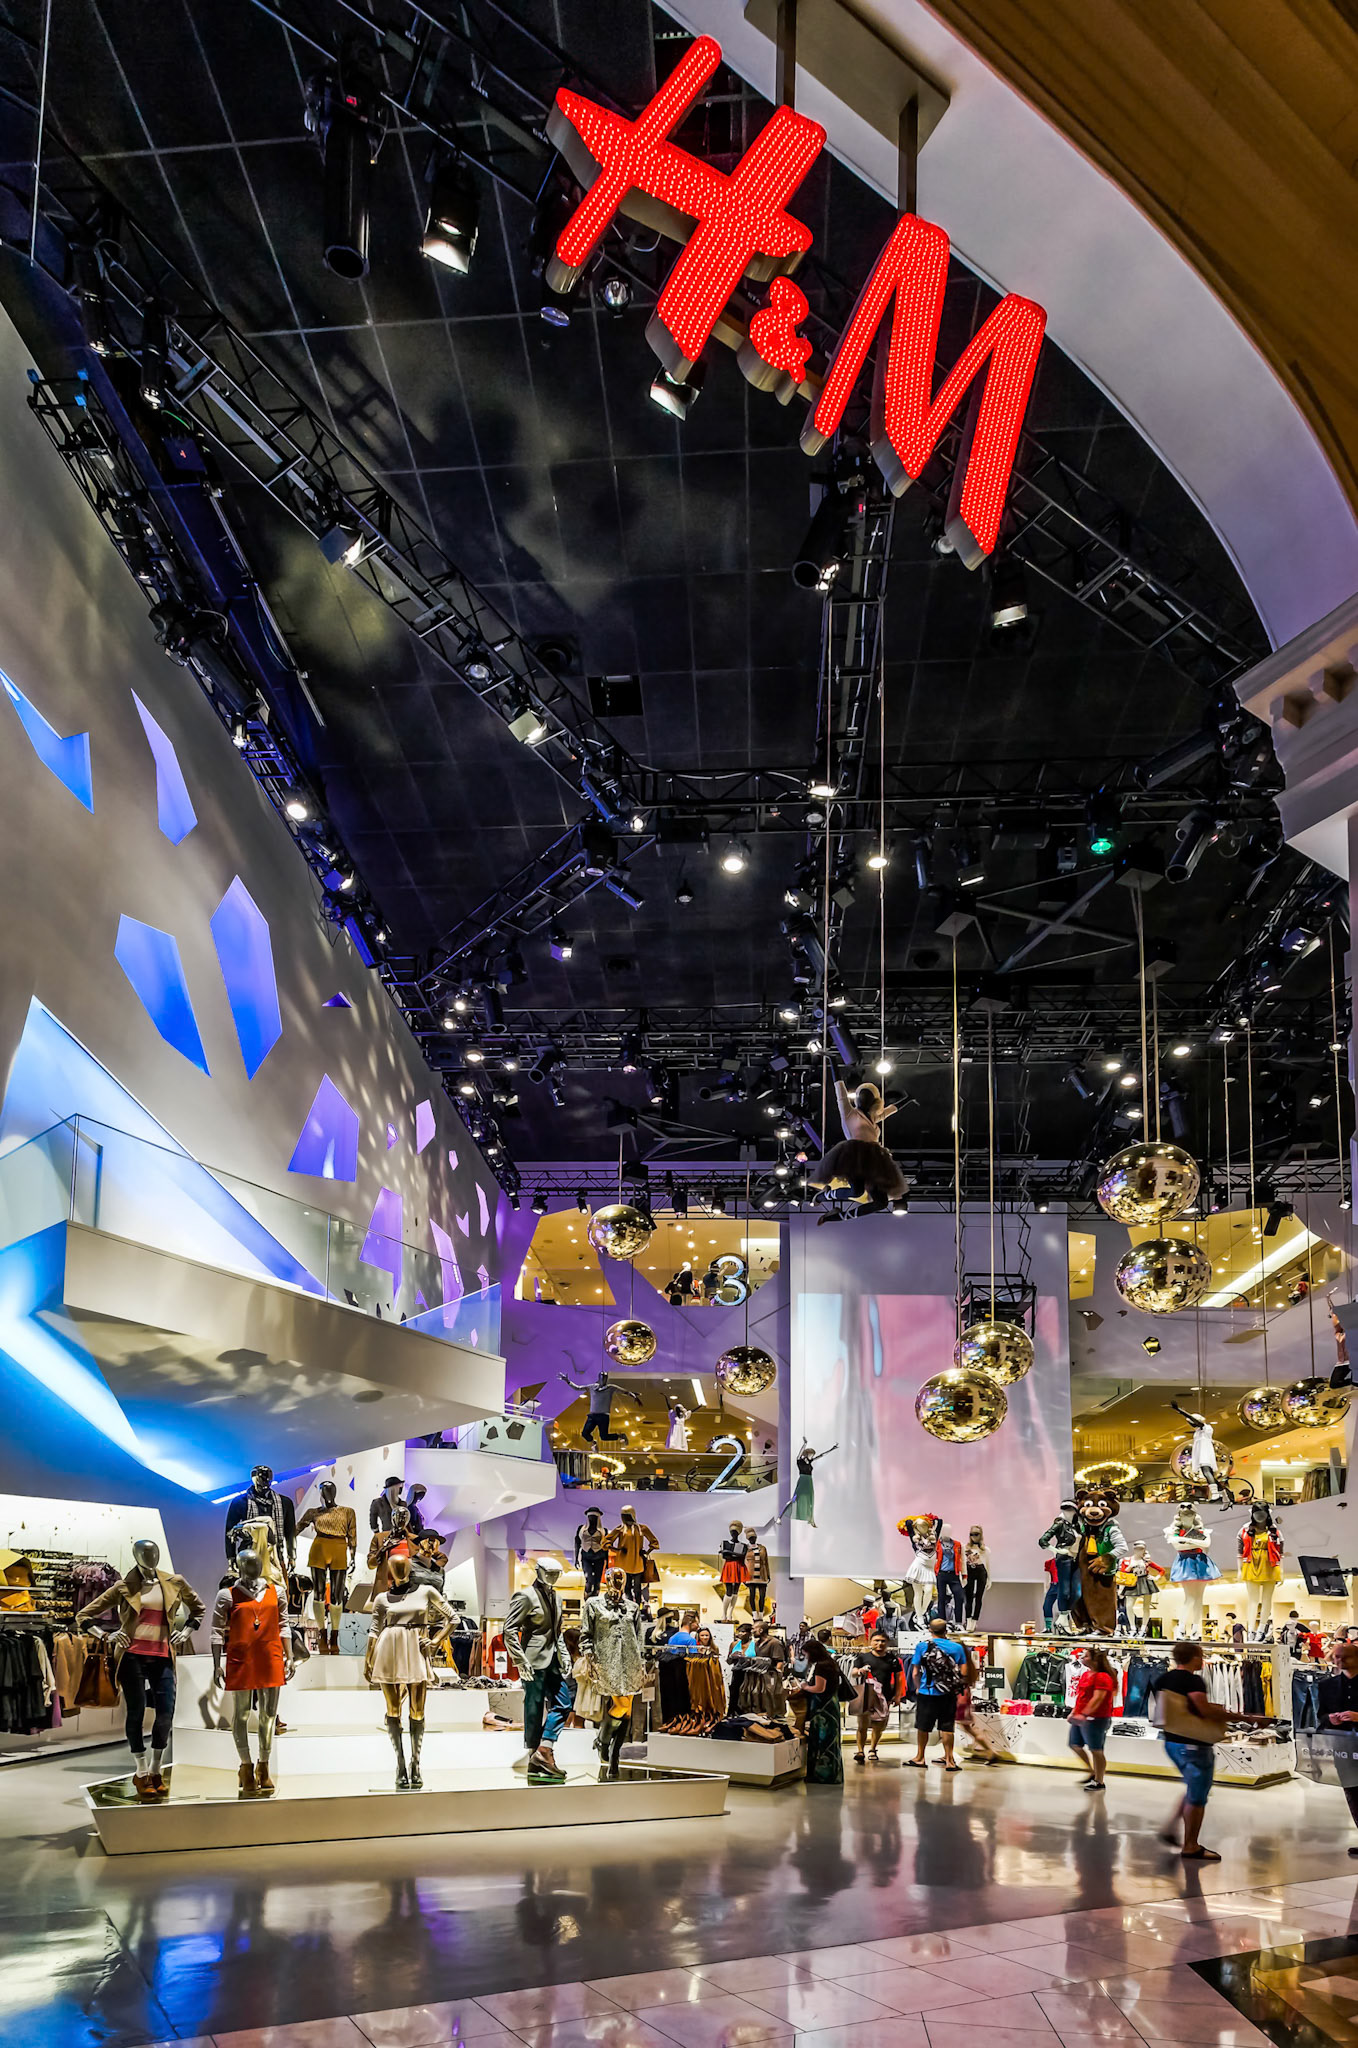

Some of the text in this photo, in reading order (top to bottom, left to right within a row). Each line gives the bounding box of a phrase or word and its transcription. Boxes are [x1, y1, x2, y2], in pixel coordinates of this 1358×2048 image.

[548, 33, 1048, 560] H&M
[712, 1253, 748, 1306] 3
[706, 1436, 749, 1493] 2
